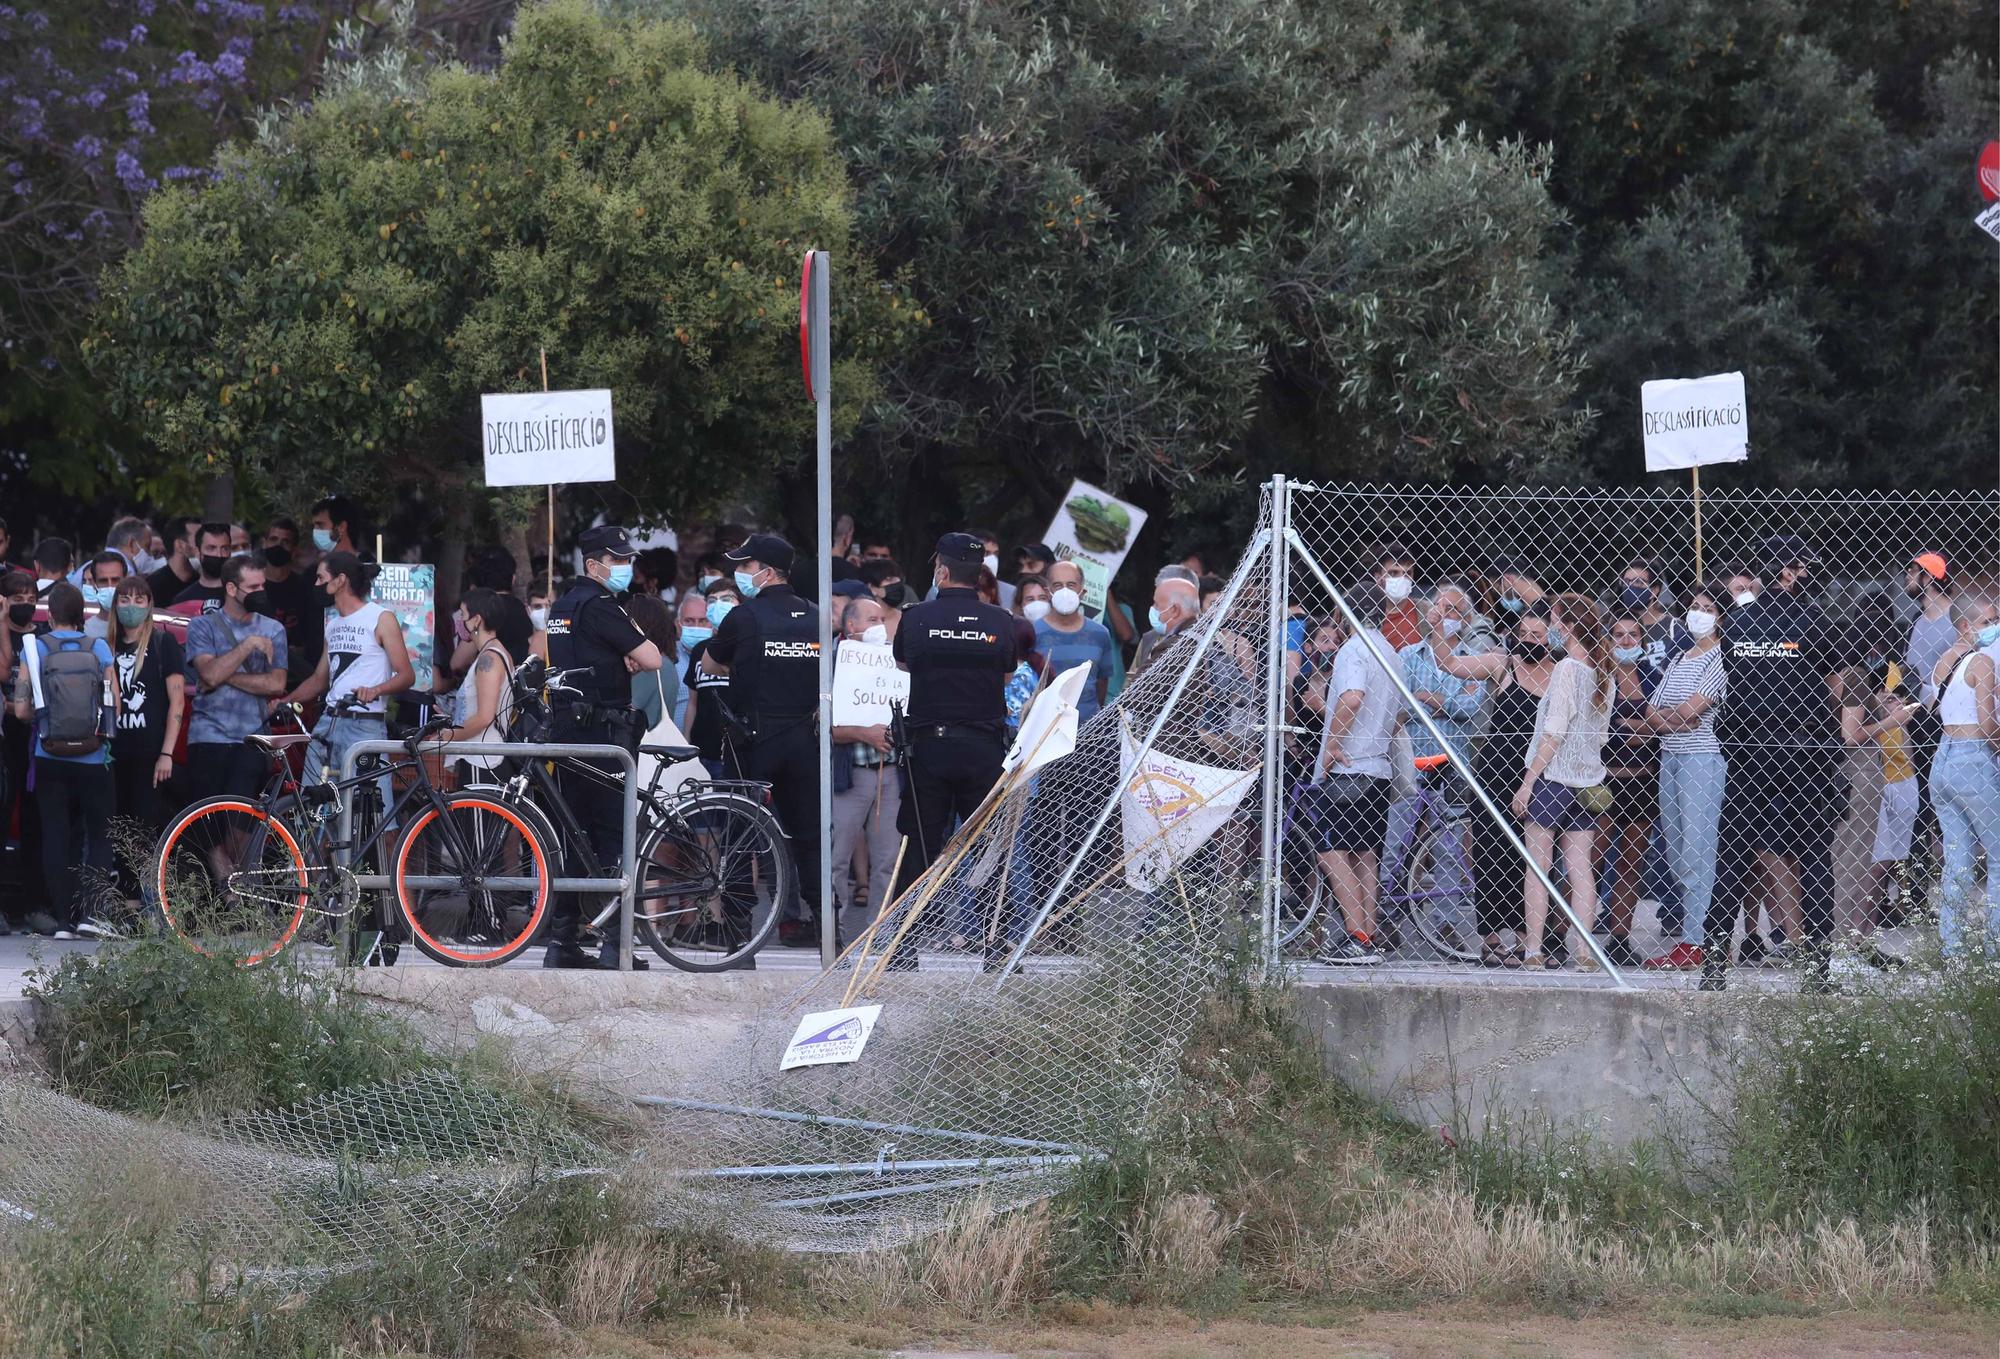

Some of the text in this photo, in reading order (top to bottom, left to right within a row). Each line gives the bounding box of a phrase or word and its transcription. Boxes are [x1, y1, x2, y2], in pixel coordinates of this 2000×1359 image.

[370, 588, 425, 602] L'HORTA
[929, 629, 988, 641] POLICIA
[764, 641, 813, 650] POLICIA
[1733, 641, 1784, 650] POLICIA
[764, 649, 820, 658] NACIONAL
[1733, 649, 1799, 658] NACIONAL
